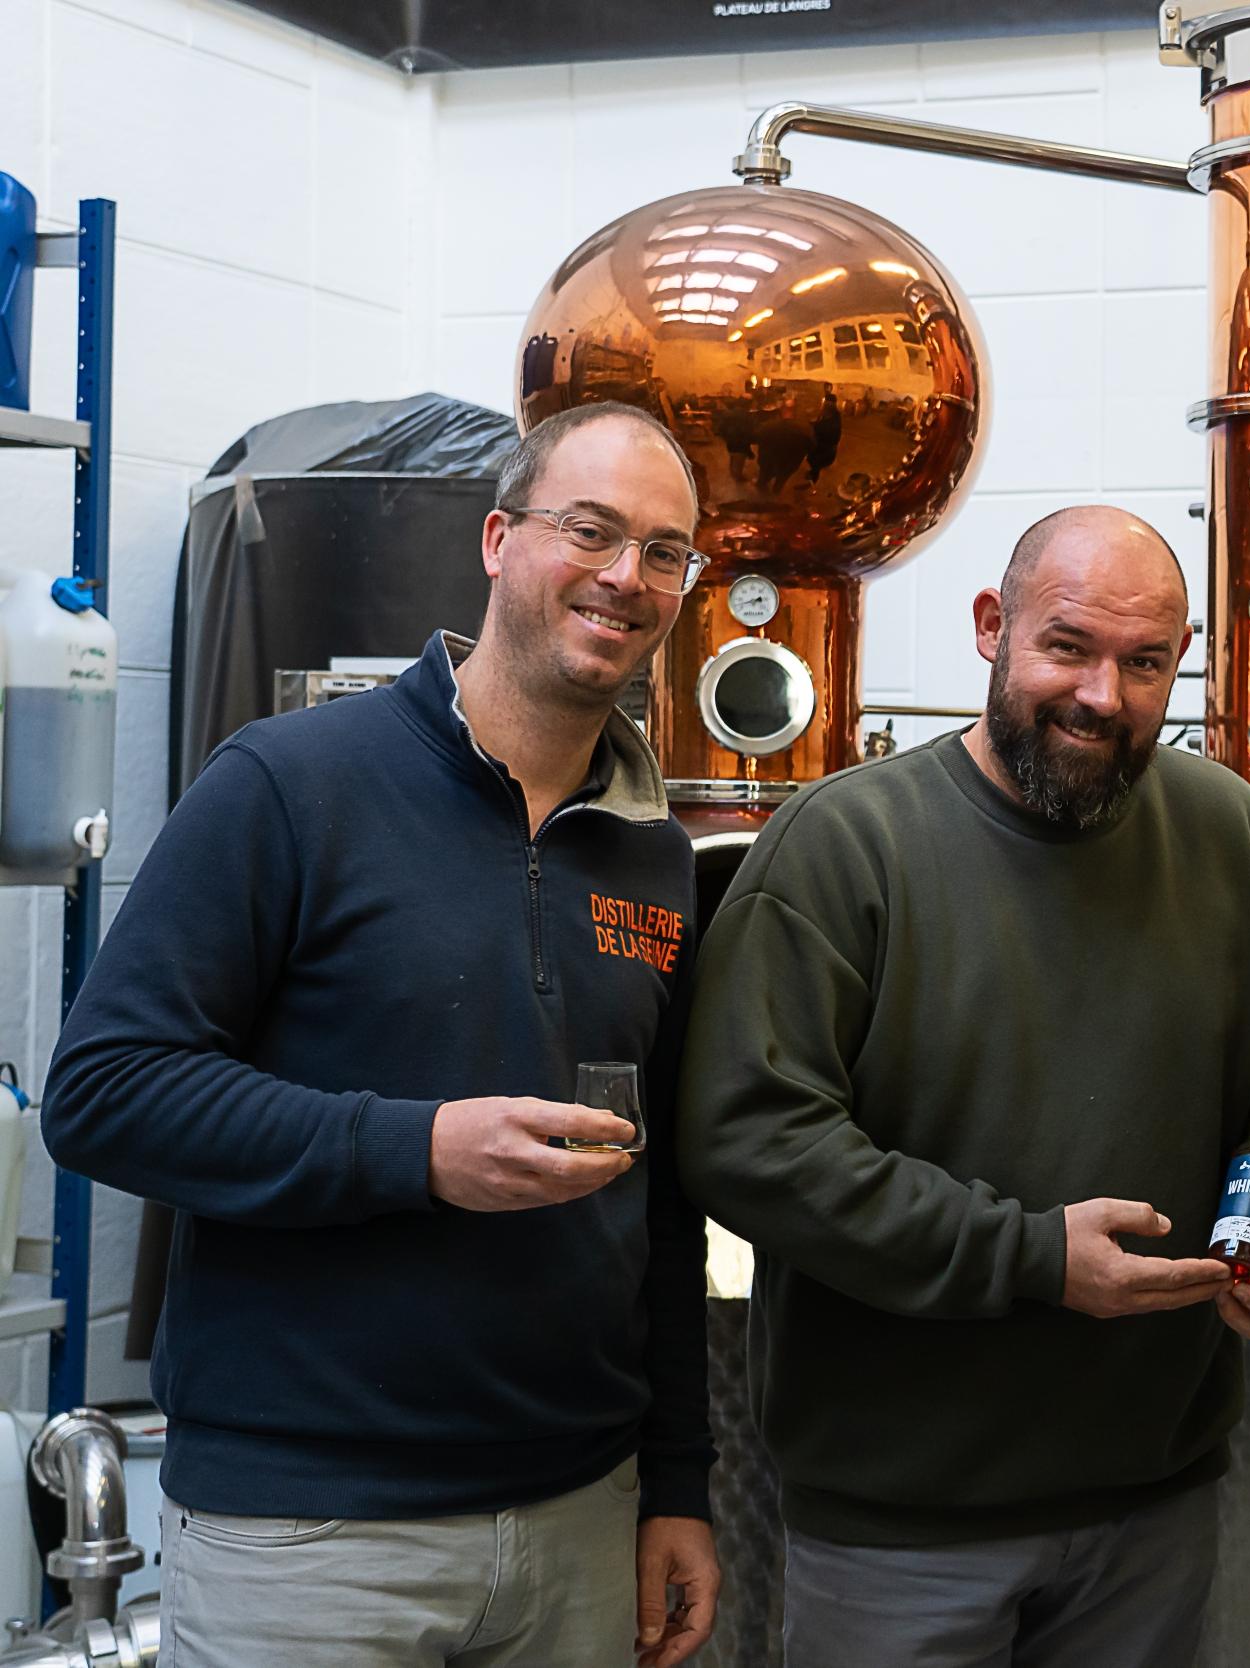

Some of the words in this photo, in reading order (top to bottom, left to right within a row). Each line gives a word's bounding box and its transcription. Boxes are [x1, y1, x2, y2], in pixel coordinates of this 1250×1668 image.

[714, 3, 763, 16] PLATEAU
[764, 2, 779, 13] DE
[591, 893, 683, 940] DISTILLERIE
[595, 925, 619, 956] DE
[620, 931, 641, 960] LA
